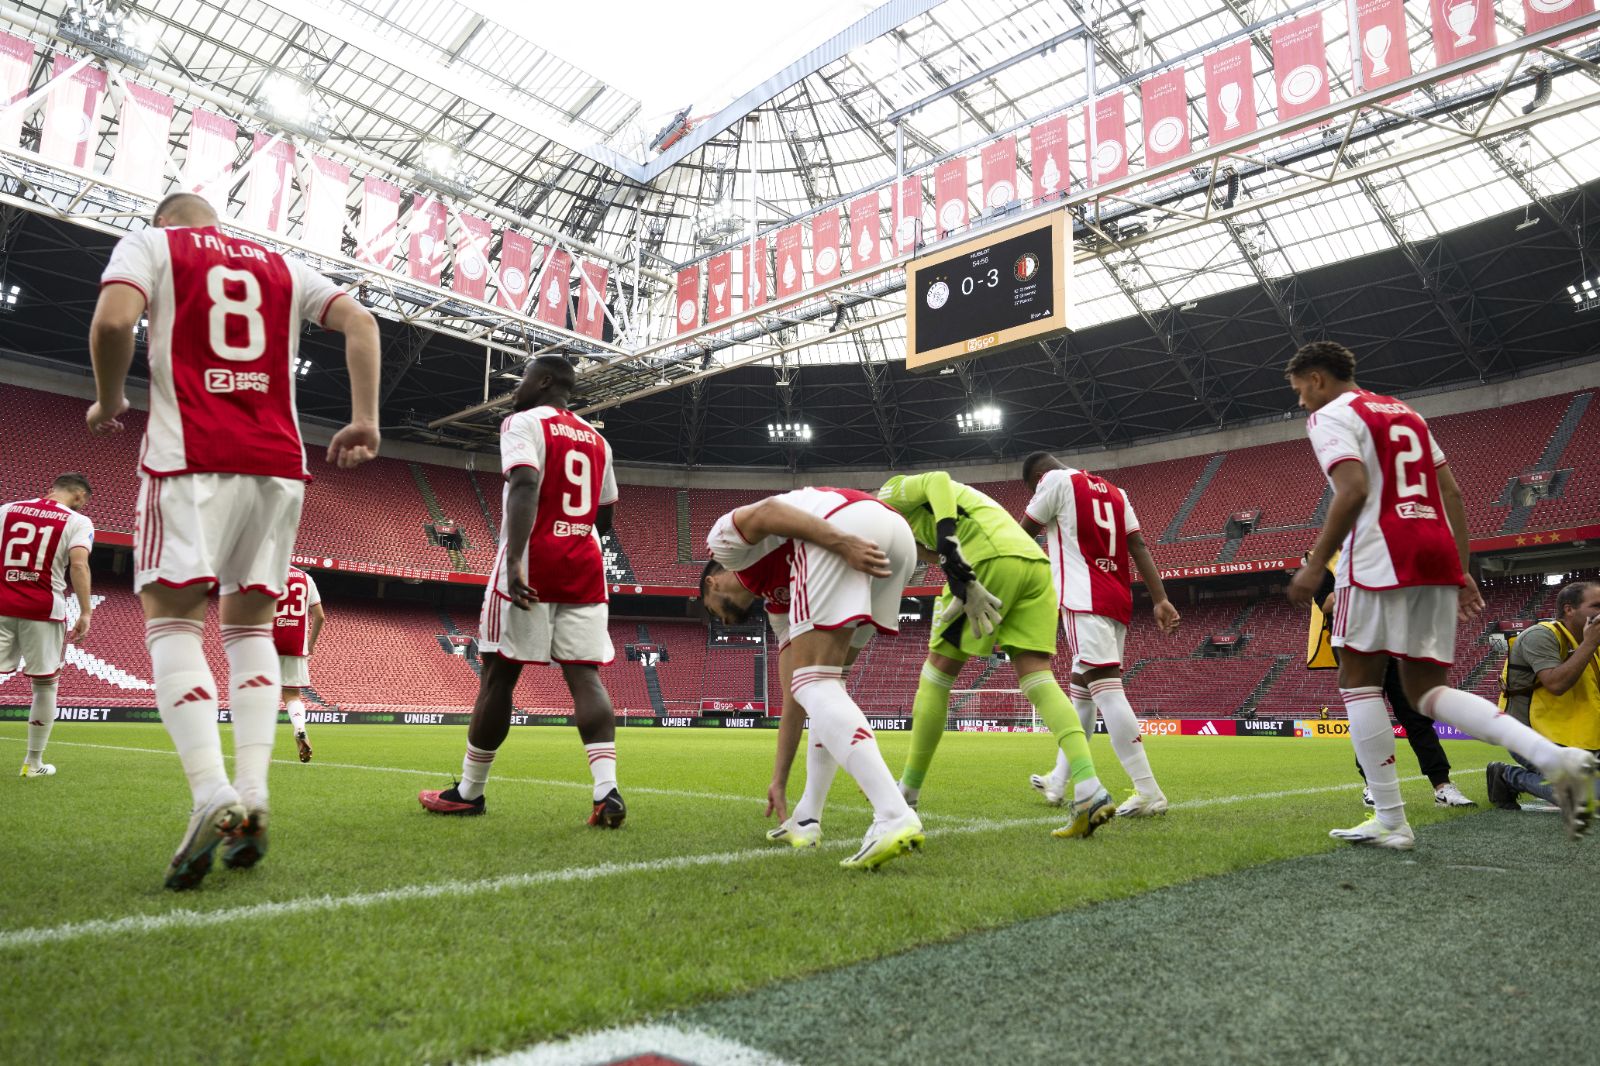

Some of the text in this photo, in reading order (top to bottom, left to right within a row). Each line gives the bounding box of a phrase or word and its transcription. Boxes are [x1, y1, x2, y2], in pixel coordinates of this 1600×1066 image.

[190, 231, 269, 264] TAYLOR
[961, 276, 974, 295] 0
[986, 268, 999, 288] 3
[206, 264, 266, 362] 8
[236, 381, 269, 395] SPOR
[549, 423, 597, 446] BROBBEY
[1389, 425, 1428, 498] 2
[562, 449, 592, 517] 9
[22, 506, 40, 518] DEN
[39, 509, 69, 522] BOOME
[1092, 498, 1116, 557] 4
[4, 521, 55, 571] 21
[291, 556, 318, 565] IOEN
[1160, 560, 1285, 580] JAX F-SIDE SINDS 1976
[273, 582, 307, 617] 23
[404, 714, 444, 724] UNIBET
[510, 715, 529, 725] BET
[725, 718, 755, 728] UNIBET
[870, 719, 907, 730] UNIBET
[1245, 720, 1284, 731] UNIBET
[1317, 723, 1351, 735] BLOX
